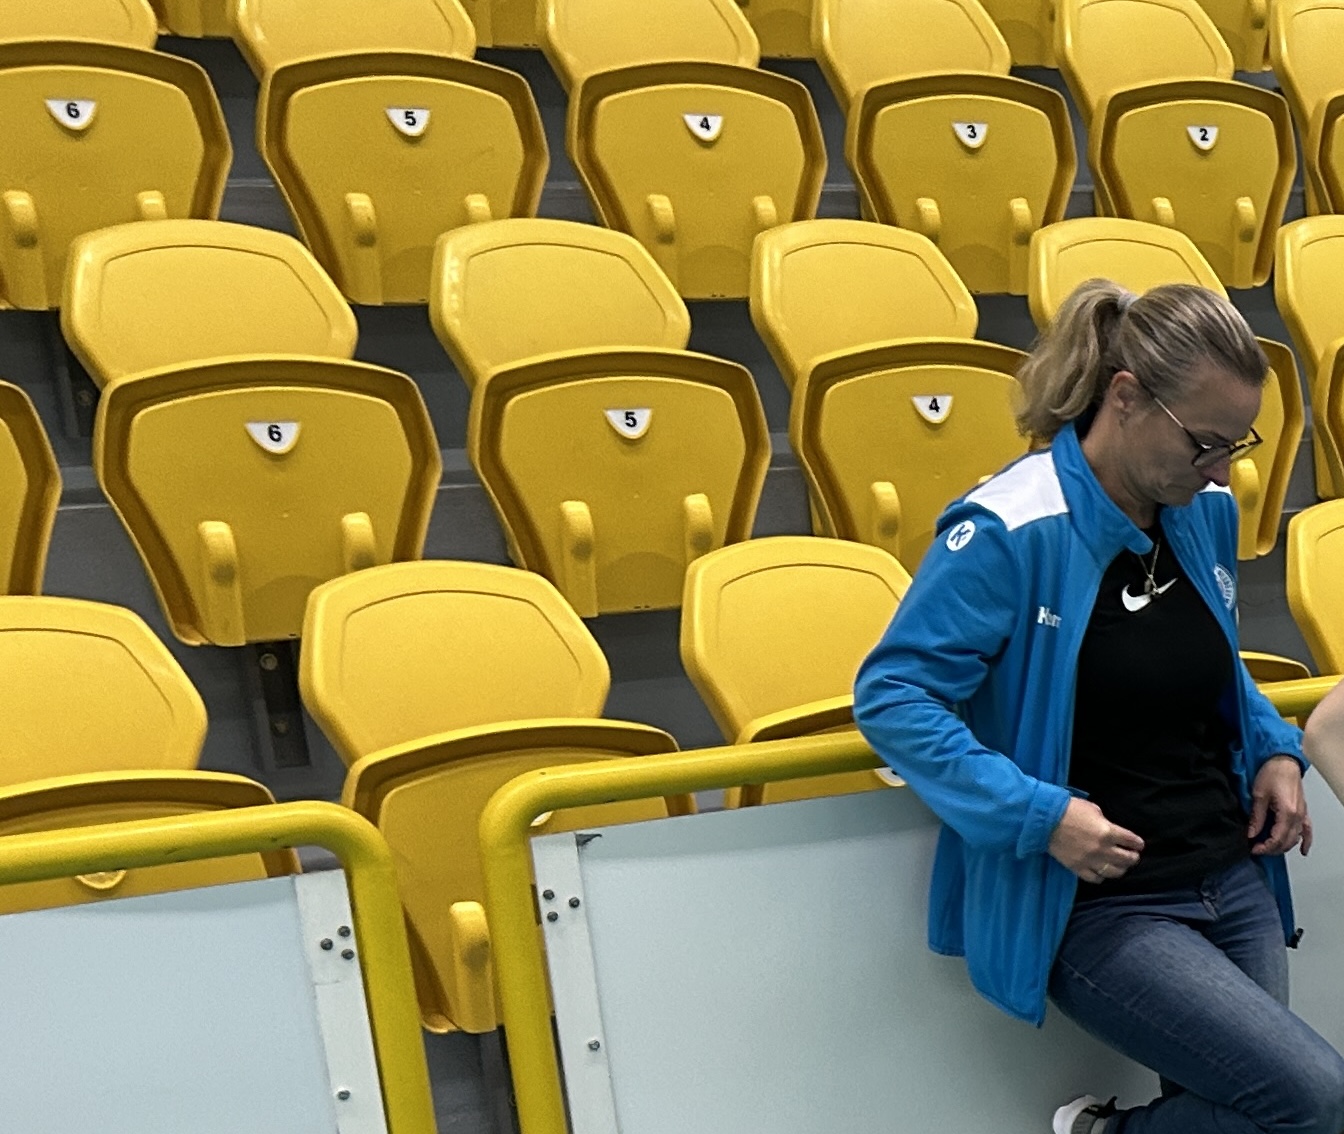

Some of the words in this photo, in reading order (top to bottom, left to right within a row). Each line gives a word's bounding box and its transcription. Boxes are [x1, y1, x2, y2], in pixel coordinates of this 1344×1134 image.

[66, 102, 80, 119] 6
[404, 110, 417, 127] 5
[699, 116, 711, 131] 4
[966, 124, 977, 139] 3
[1199, 127, 1209, 142] 2
[928, 397, 941, 413] 4
[624, 411, 637, 428] 5
[267, 424, 282, 443] 6
